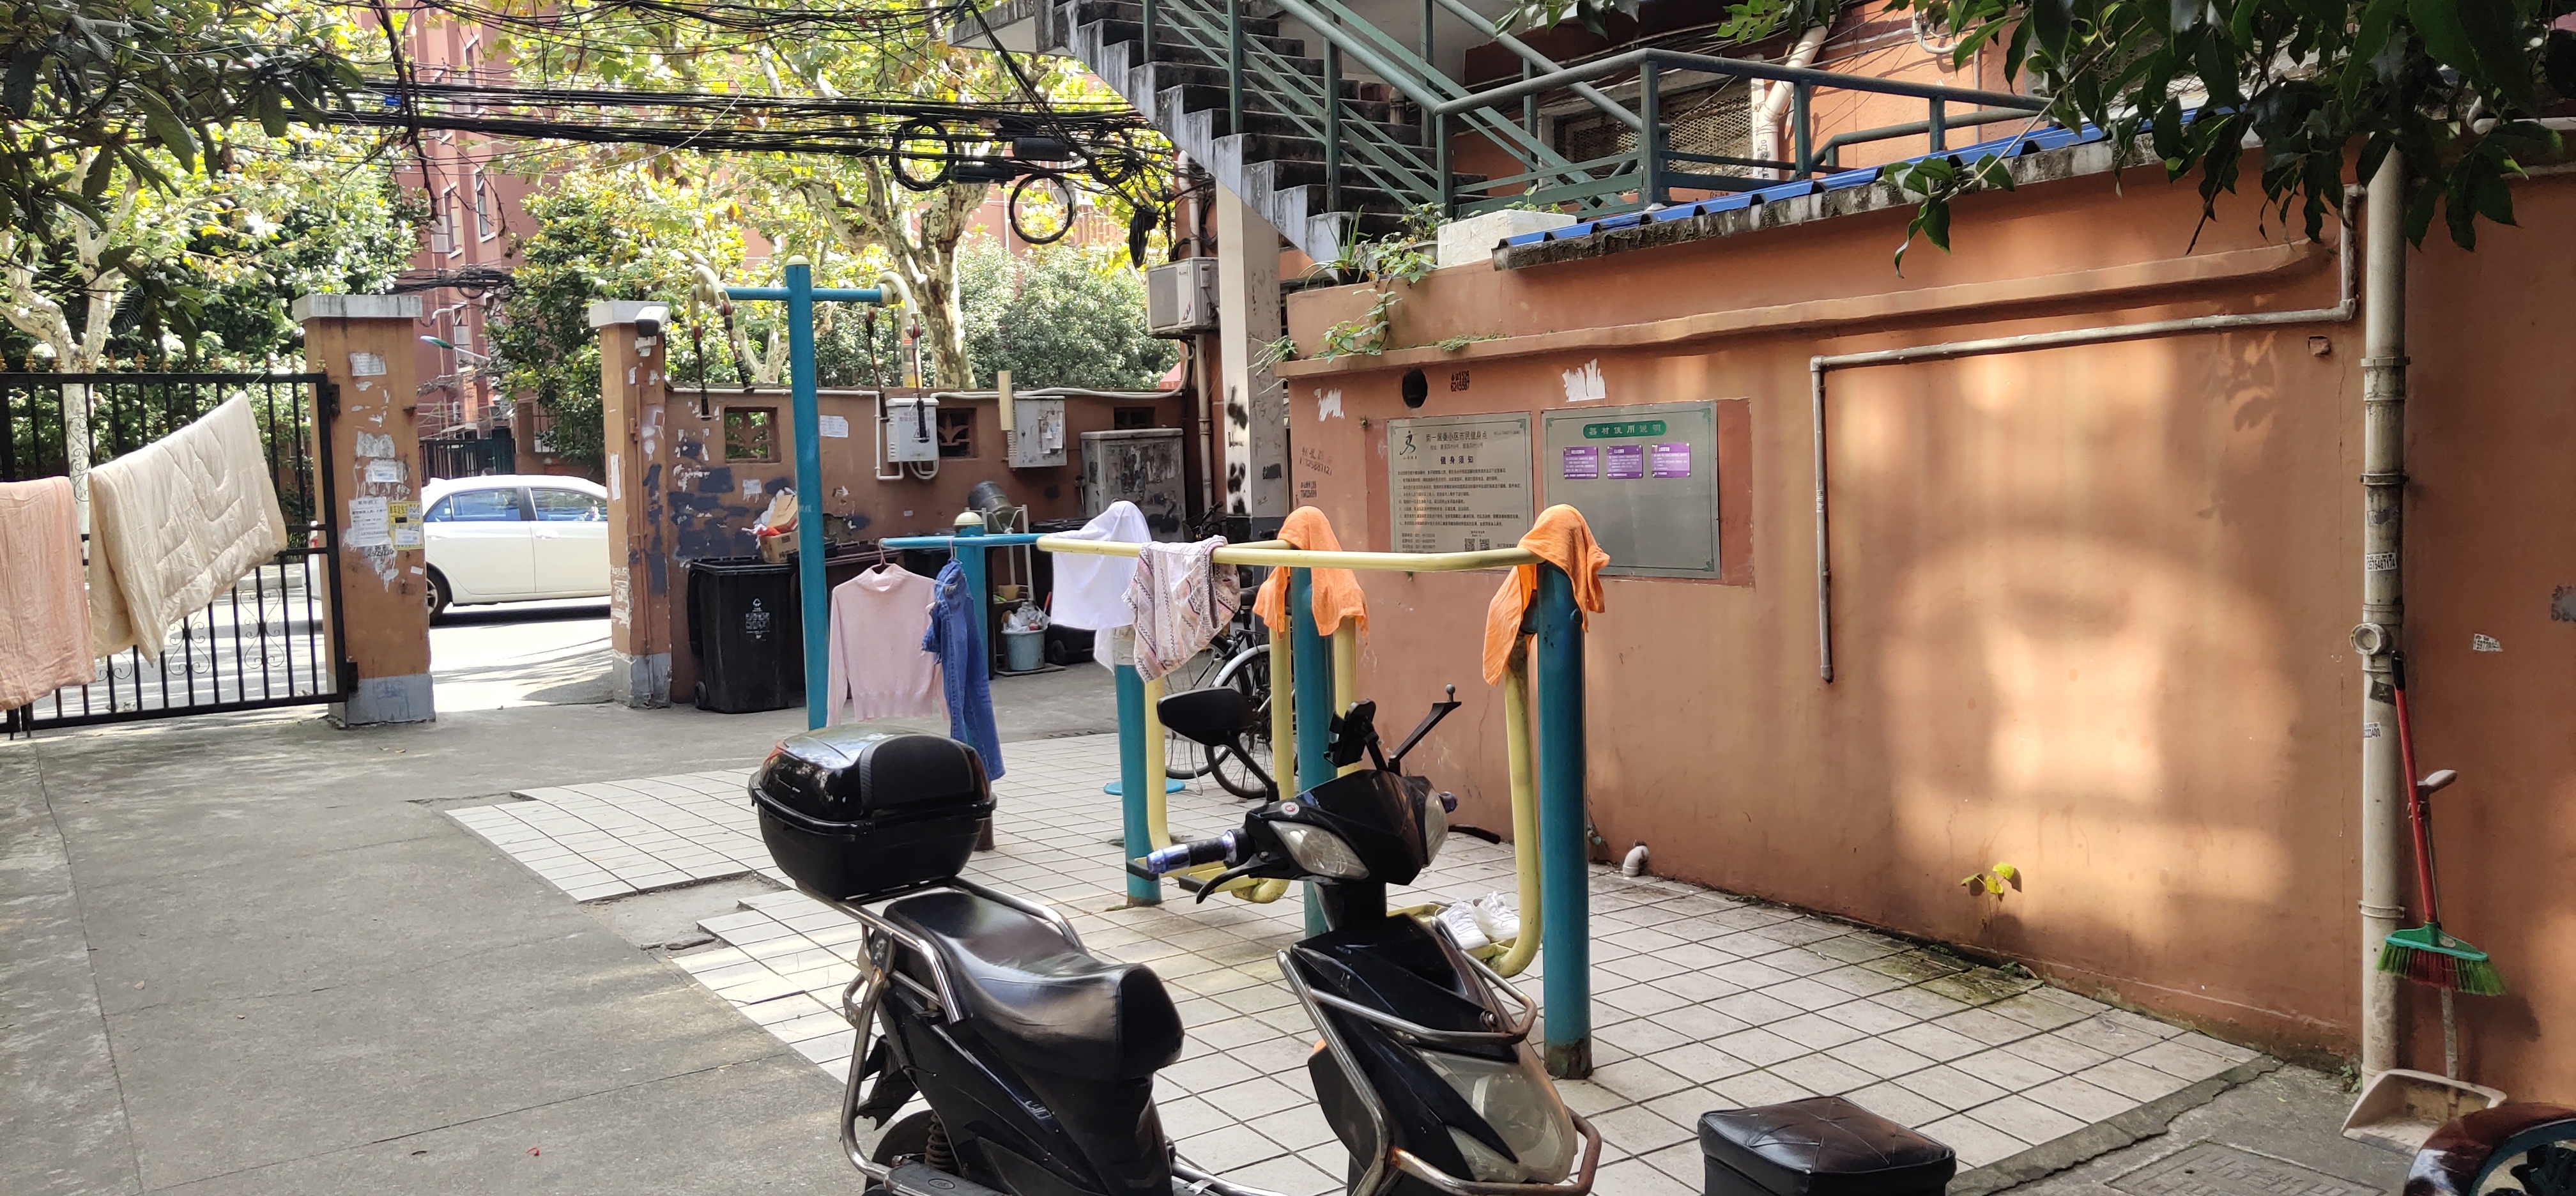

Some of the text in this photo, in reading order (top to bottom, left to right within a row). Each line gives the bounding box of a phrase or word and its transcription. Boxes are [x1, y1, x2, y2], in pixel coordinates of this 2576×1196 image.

[1588, 424, 1661, 435] 器材使用说明
[1440, 454, 1475, 465] 健身须知
